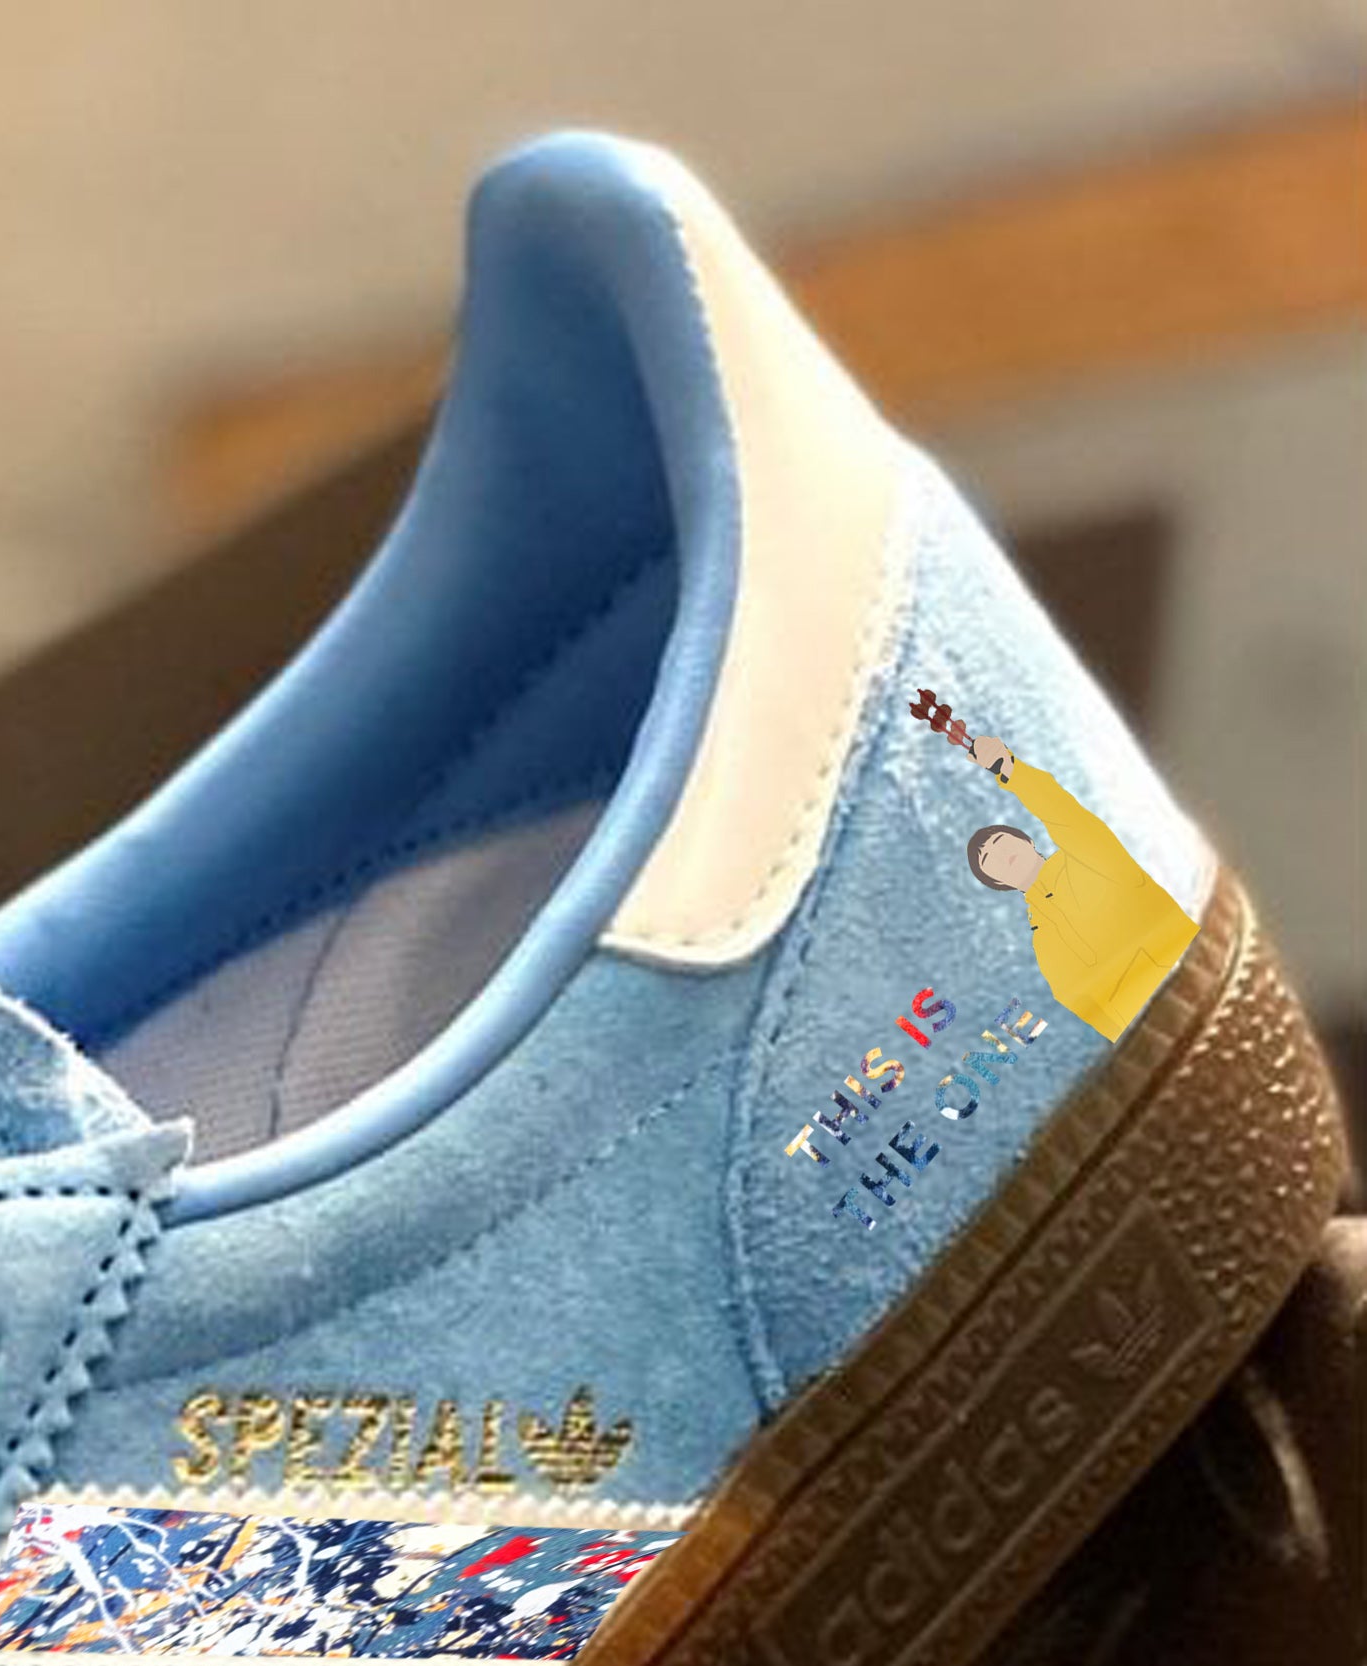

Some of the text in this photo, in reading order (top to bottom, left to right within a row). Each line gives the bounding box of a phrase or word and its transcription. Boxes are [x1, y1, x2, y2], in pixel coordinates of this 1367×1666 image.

[784, 986, 957, 1168] THIS IS
[831, 997, 1048, 1231] THE ONE
[171, 1385, 517, 1491] SPEZIAL
